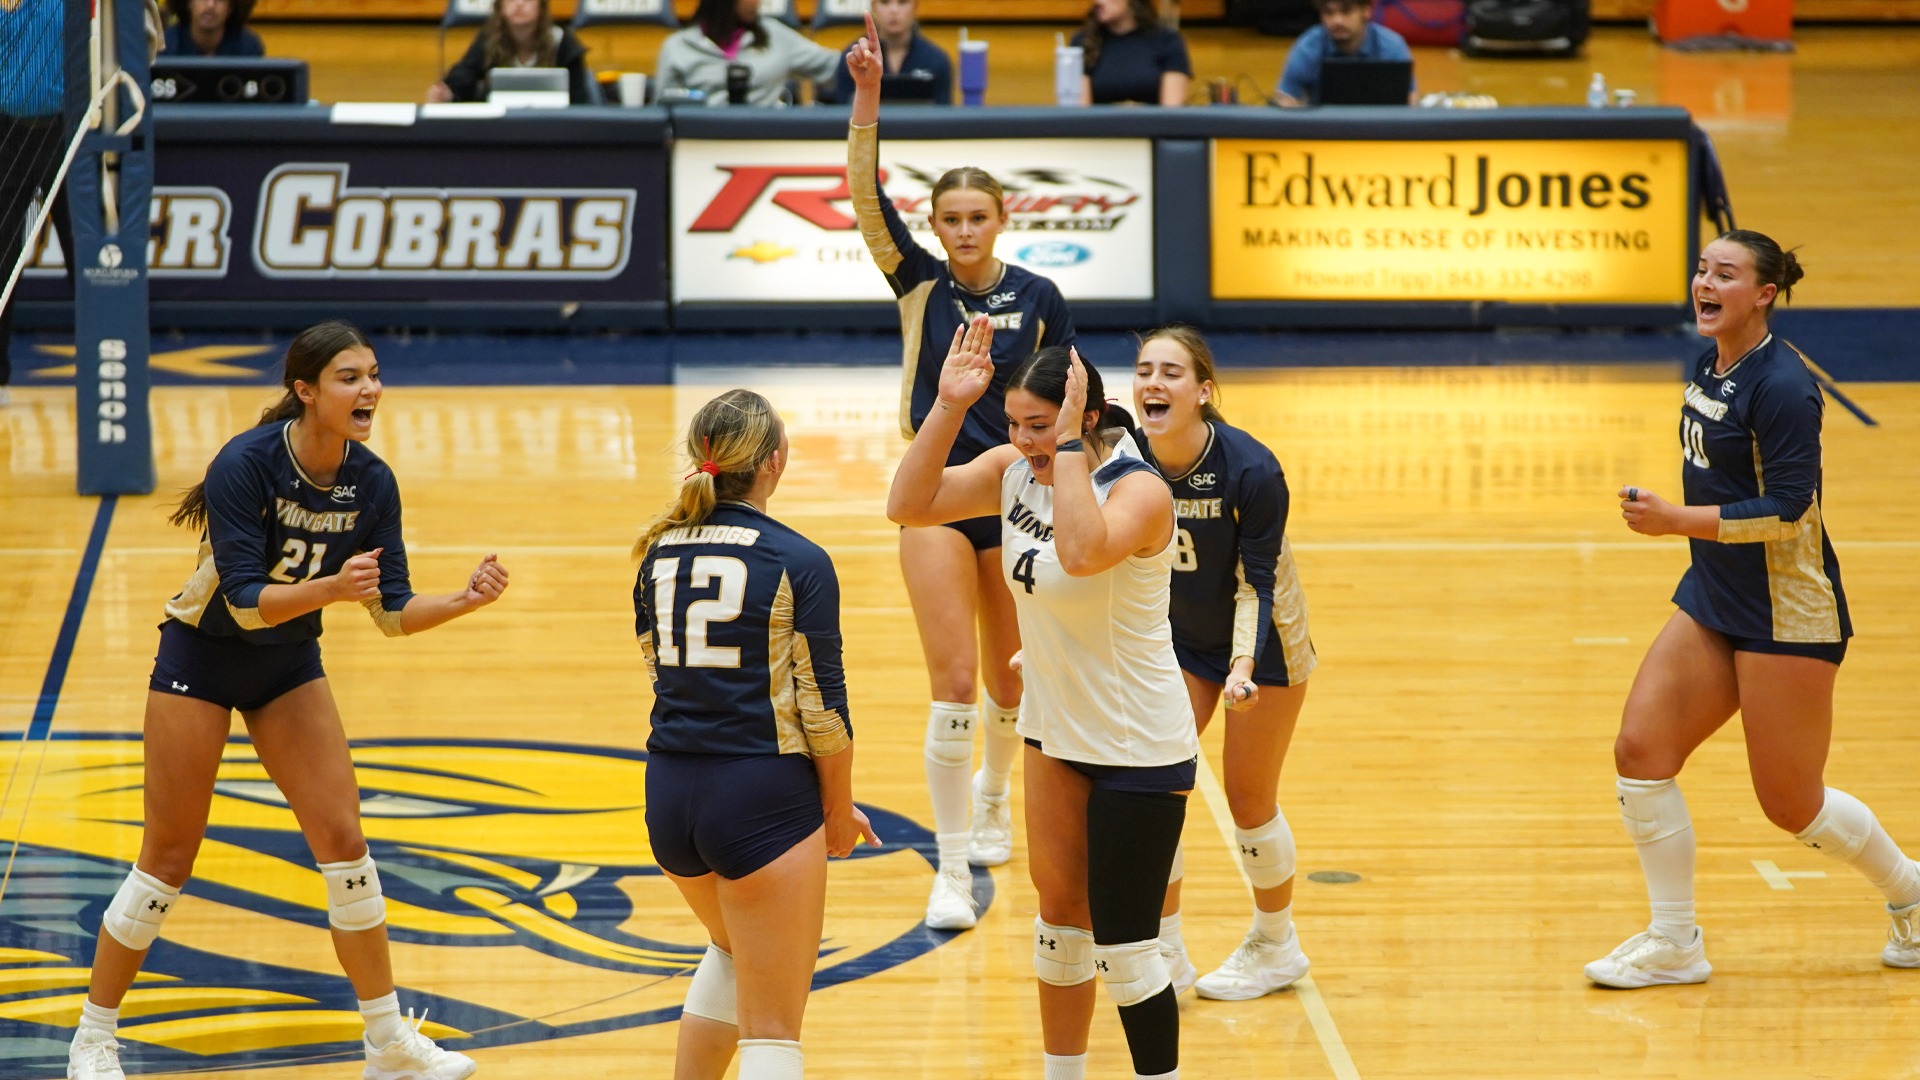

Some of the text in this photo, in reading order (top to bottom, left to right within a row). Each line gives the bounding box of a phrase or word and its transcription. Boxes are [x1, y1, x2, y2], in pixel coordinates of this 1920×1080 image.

[1242, 151, 1651, 216] Edward Jones
[1242, 227, 1650, 251] MAKING SENSE OF INVESTING
[991, 291, 1016, 306] SAC
[1683, 414, 1710, 469] 10
[332, 485, 357, 498] SAC
[1193, 473, 1216, 486] SAC
[276, 497, 360, 533] WINGATE
[656, 524, 760, 548] BULLDOGS
[269, 538, 327, 584] 21
[1013, 547, 1041, 595] 4
[651, 555, 748, 669] 12
